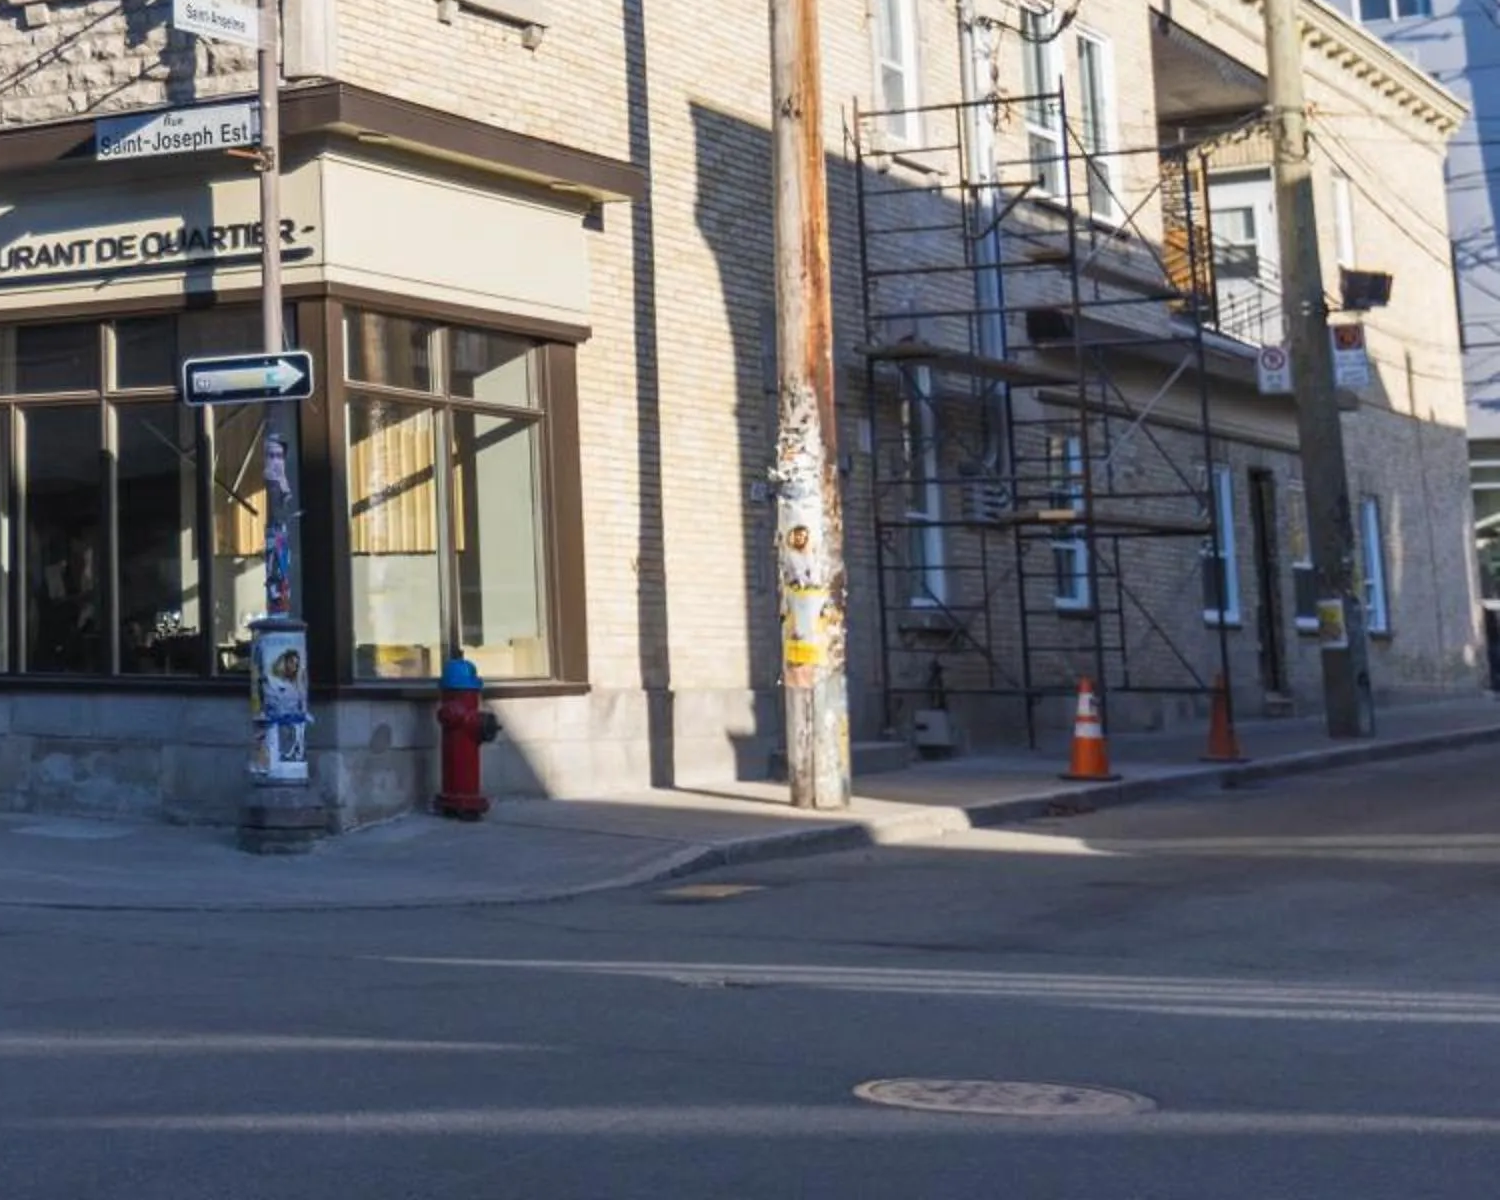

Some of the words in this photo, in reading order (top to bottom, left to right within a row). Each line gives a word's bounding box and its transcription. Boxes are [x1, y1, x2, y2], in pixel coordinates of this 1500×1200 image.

[163, 113, 184, 128] Rue
[100, 126, 214, 157] Saint-Joseph
[220, 123, 248, 144] Est
[95, 235, 137, 263] DE
[139, 219, 296, 260] QUARTIER
